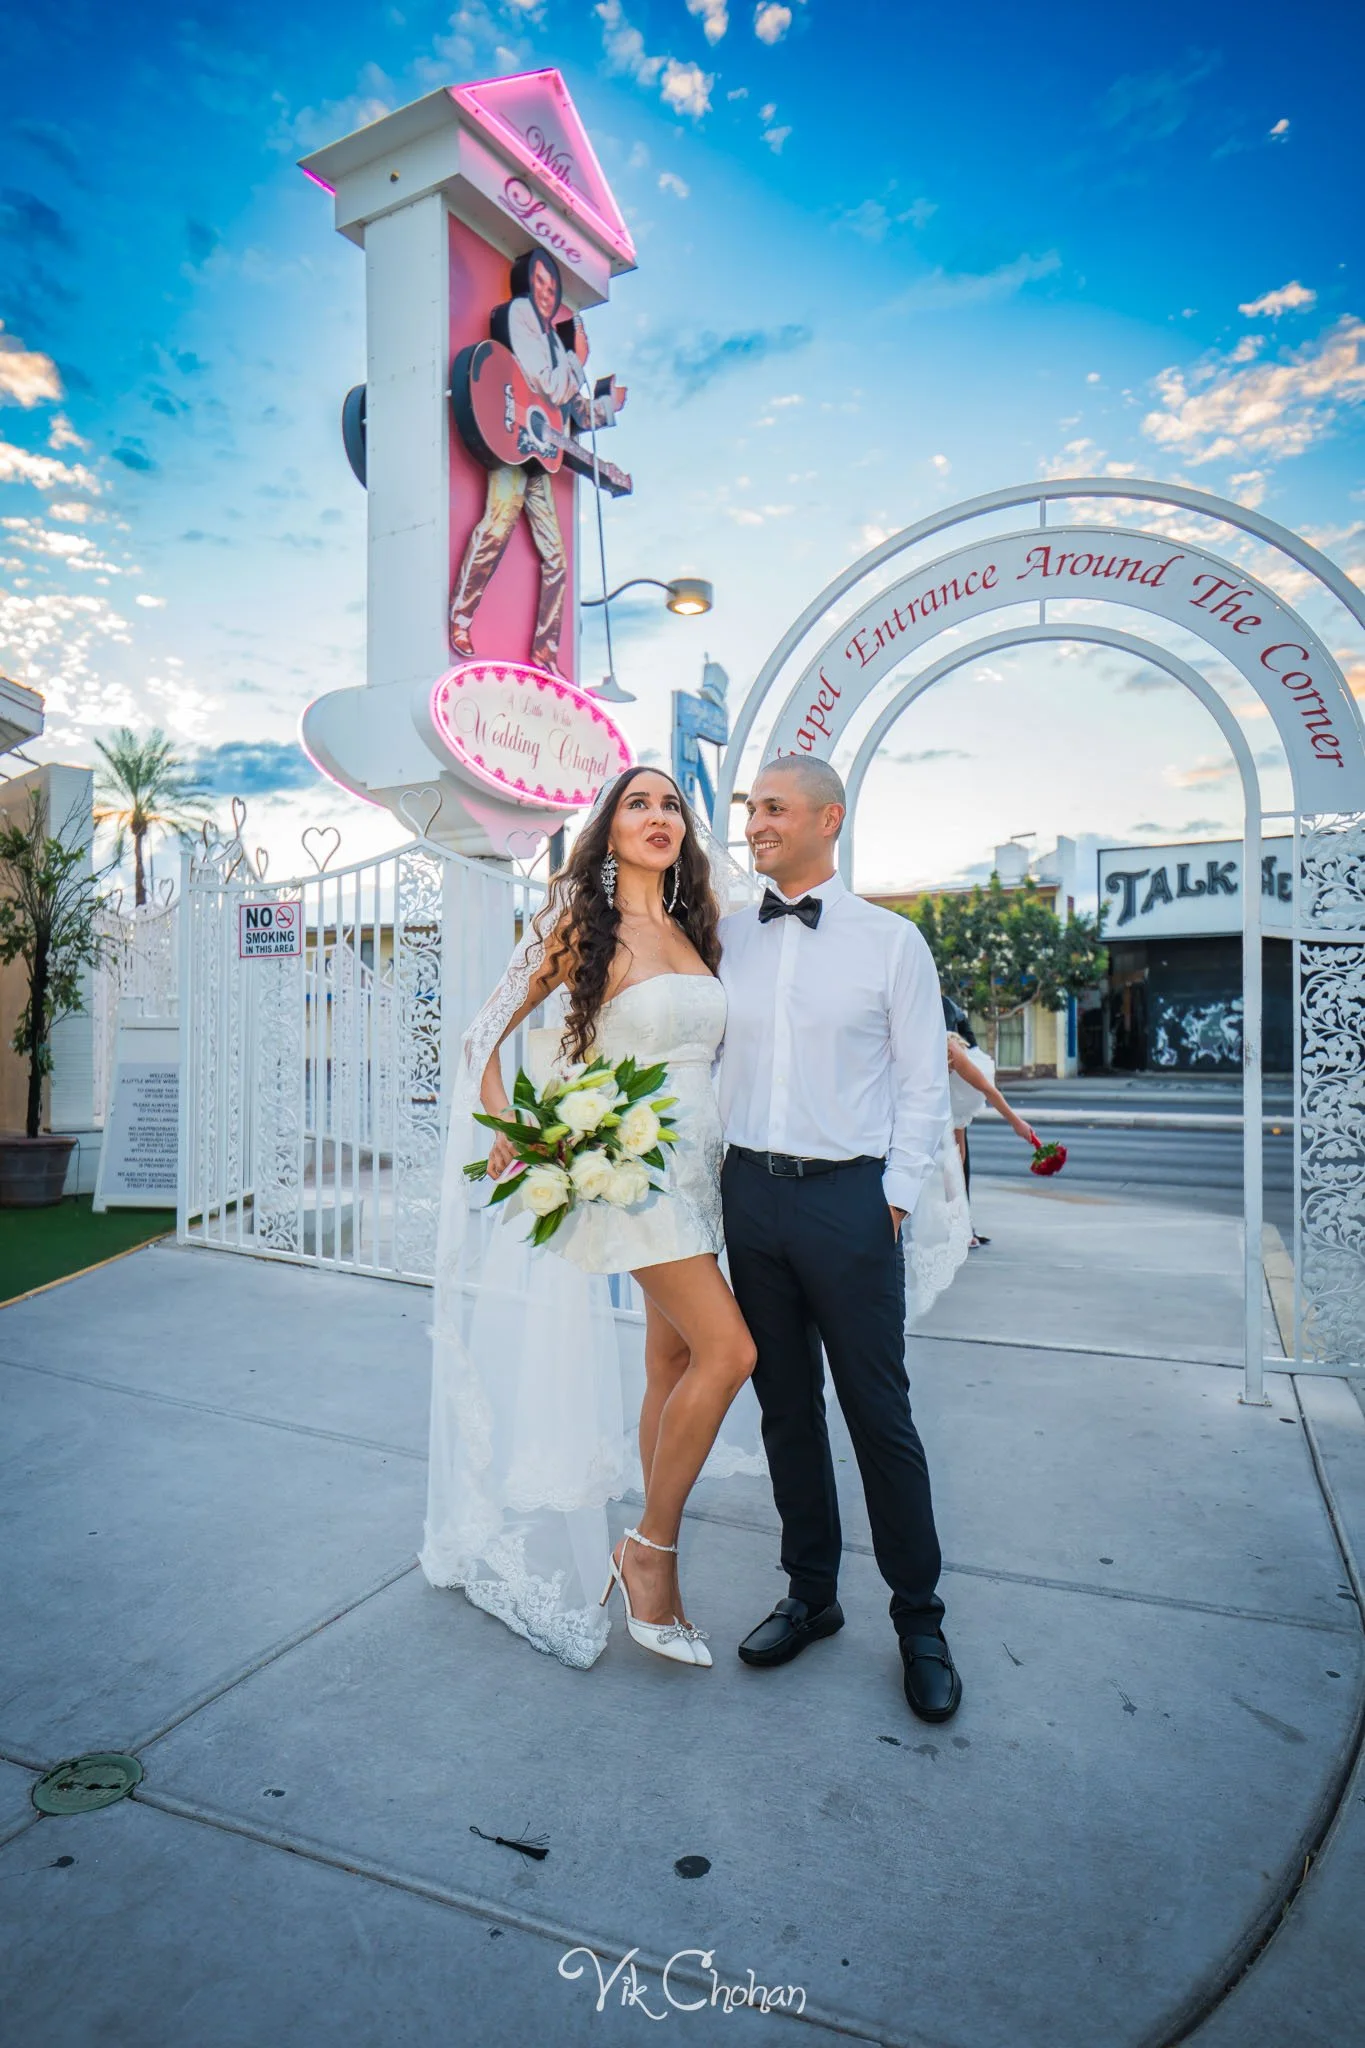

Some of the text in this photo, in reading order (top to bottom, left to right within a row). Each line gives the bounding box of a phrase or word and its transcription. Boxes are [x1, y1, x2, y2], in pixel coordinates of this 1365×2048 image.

[498, 177, 582, 264] Love
[778, 545, 1344, 768] apel Entrance Around The Corner
[453, 697, 540, 769] Wedding
[549, 728, 609, 784] Chapel
[246, 907, 273, 928] NO
[1104, 861, 1239, 927] TALK
[245, 930, 295, 945] SMOKING
[245, 944, 294, 954] IN THIS AREA
